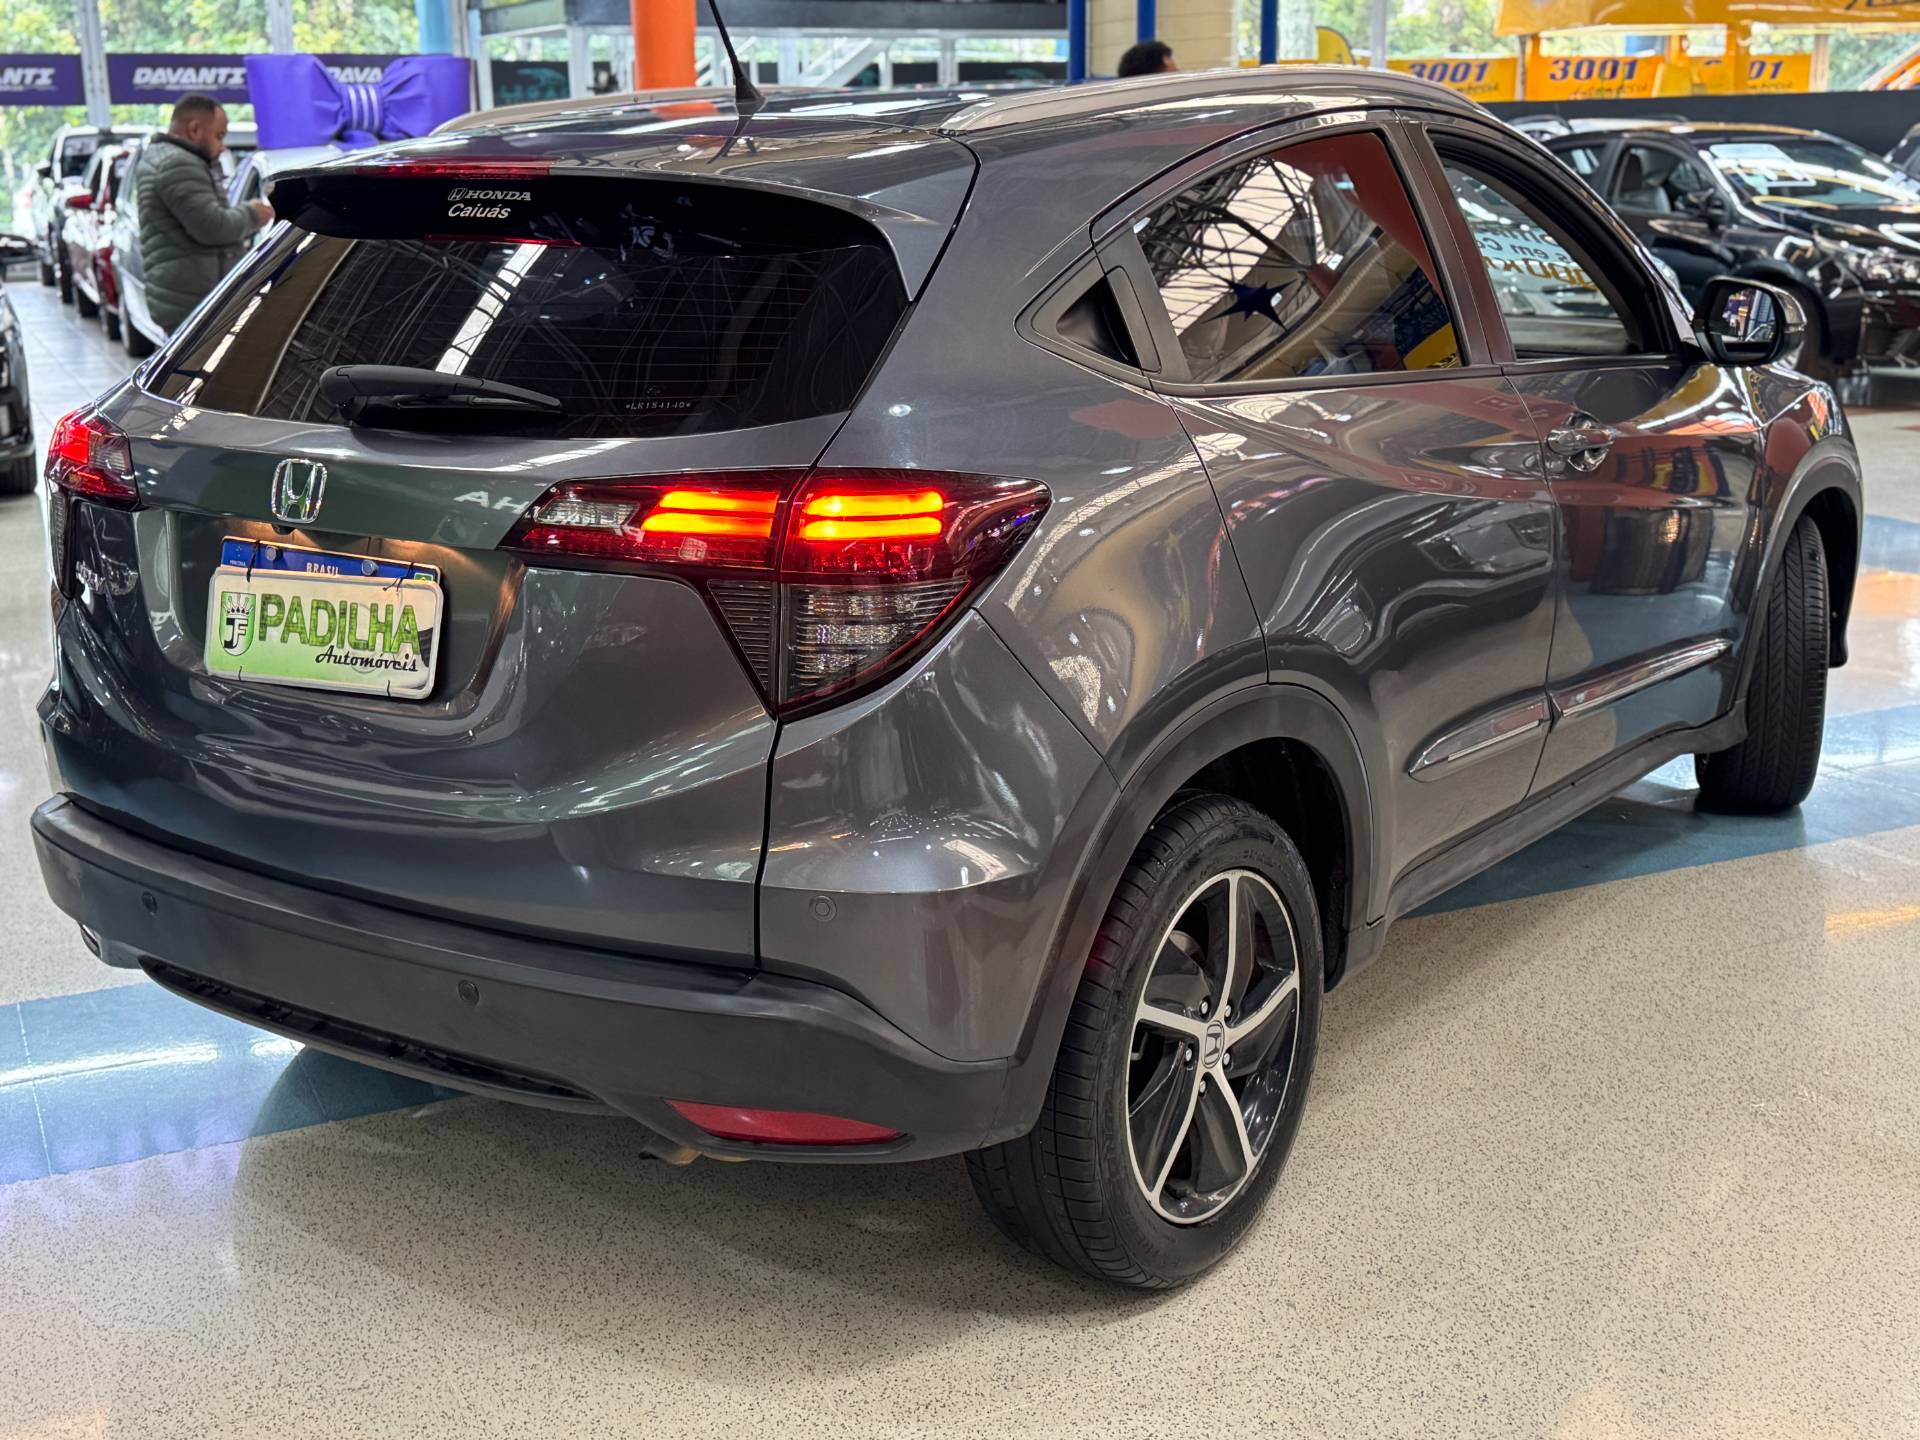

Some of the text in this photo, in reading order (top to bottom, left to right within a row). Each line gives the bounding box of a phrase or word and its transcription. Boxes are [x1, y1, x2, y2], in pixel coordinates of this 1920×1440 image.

[132, 66, 249, 86] DAVANTI
[1549, 58, 1639, 81] 3001
[464, 190, 532, 201] HONDA
[447, 202, 512, 219] Caiuás
[305, 561, 341, 577] BRASIL
[257, 592, 421, 655] PADILHA
[314, 645, 420, 673] Automóveis
